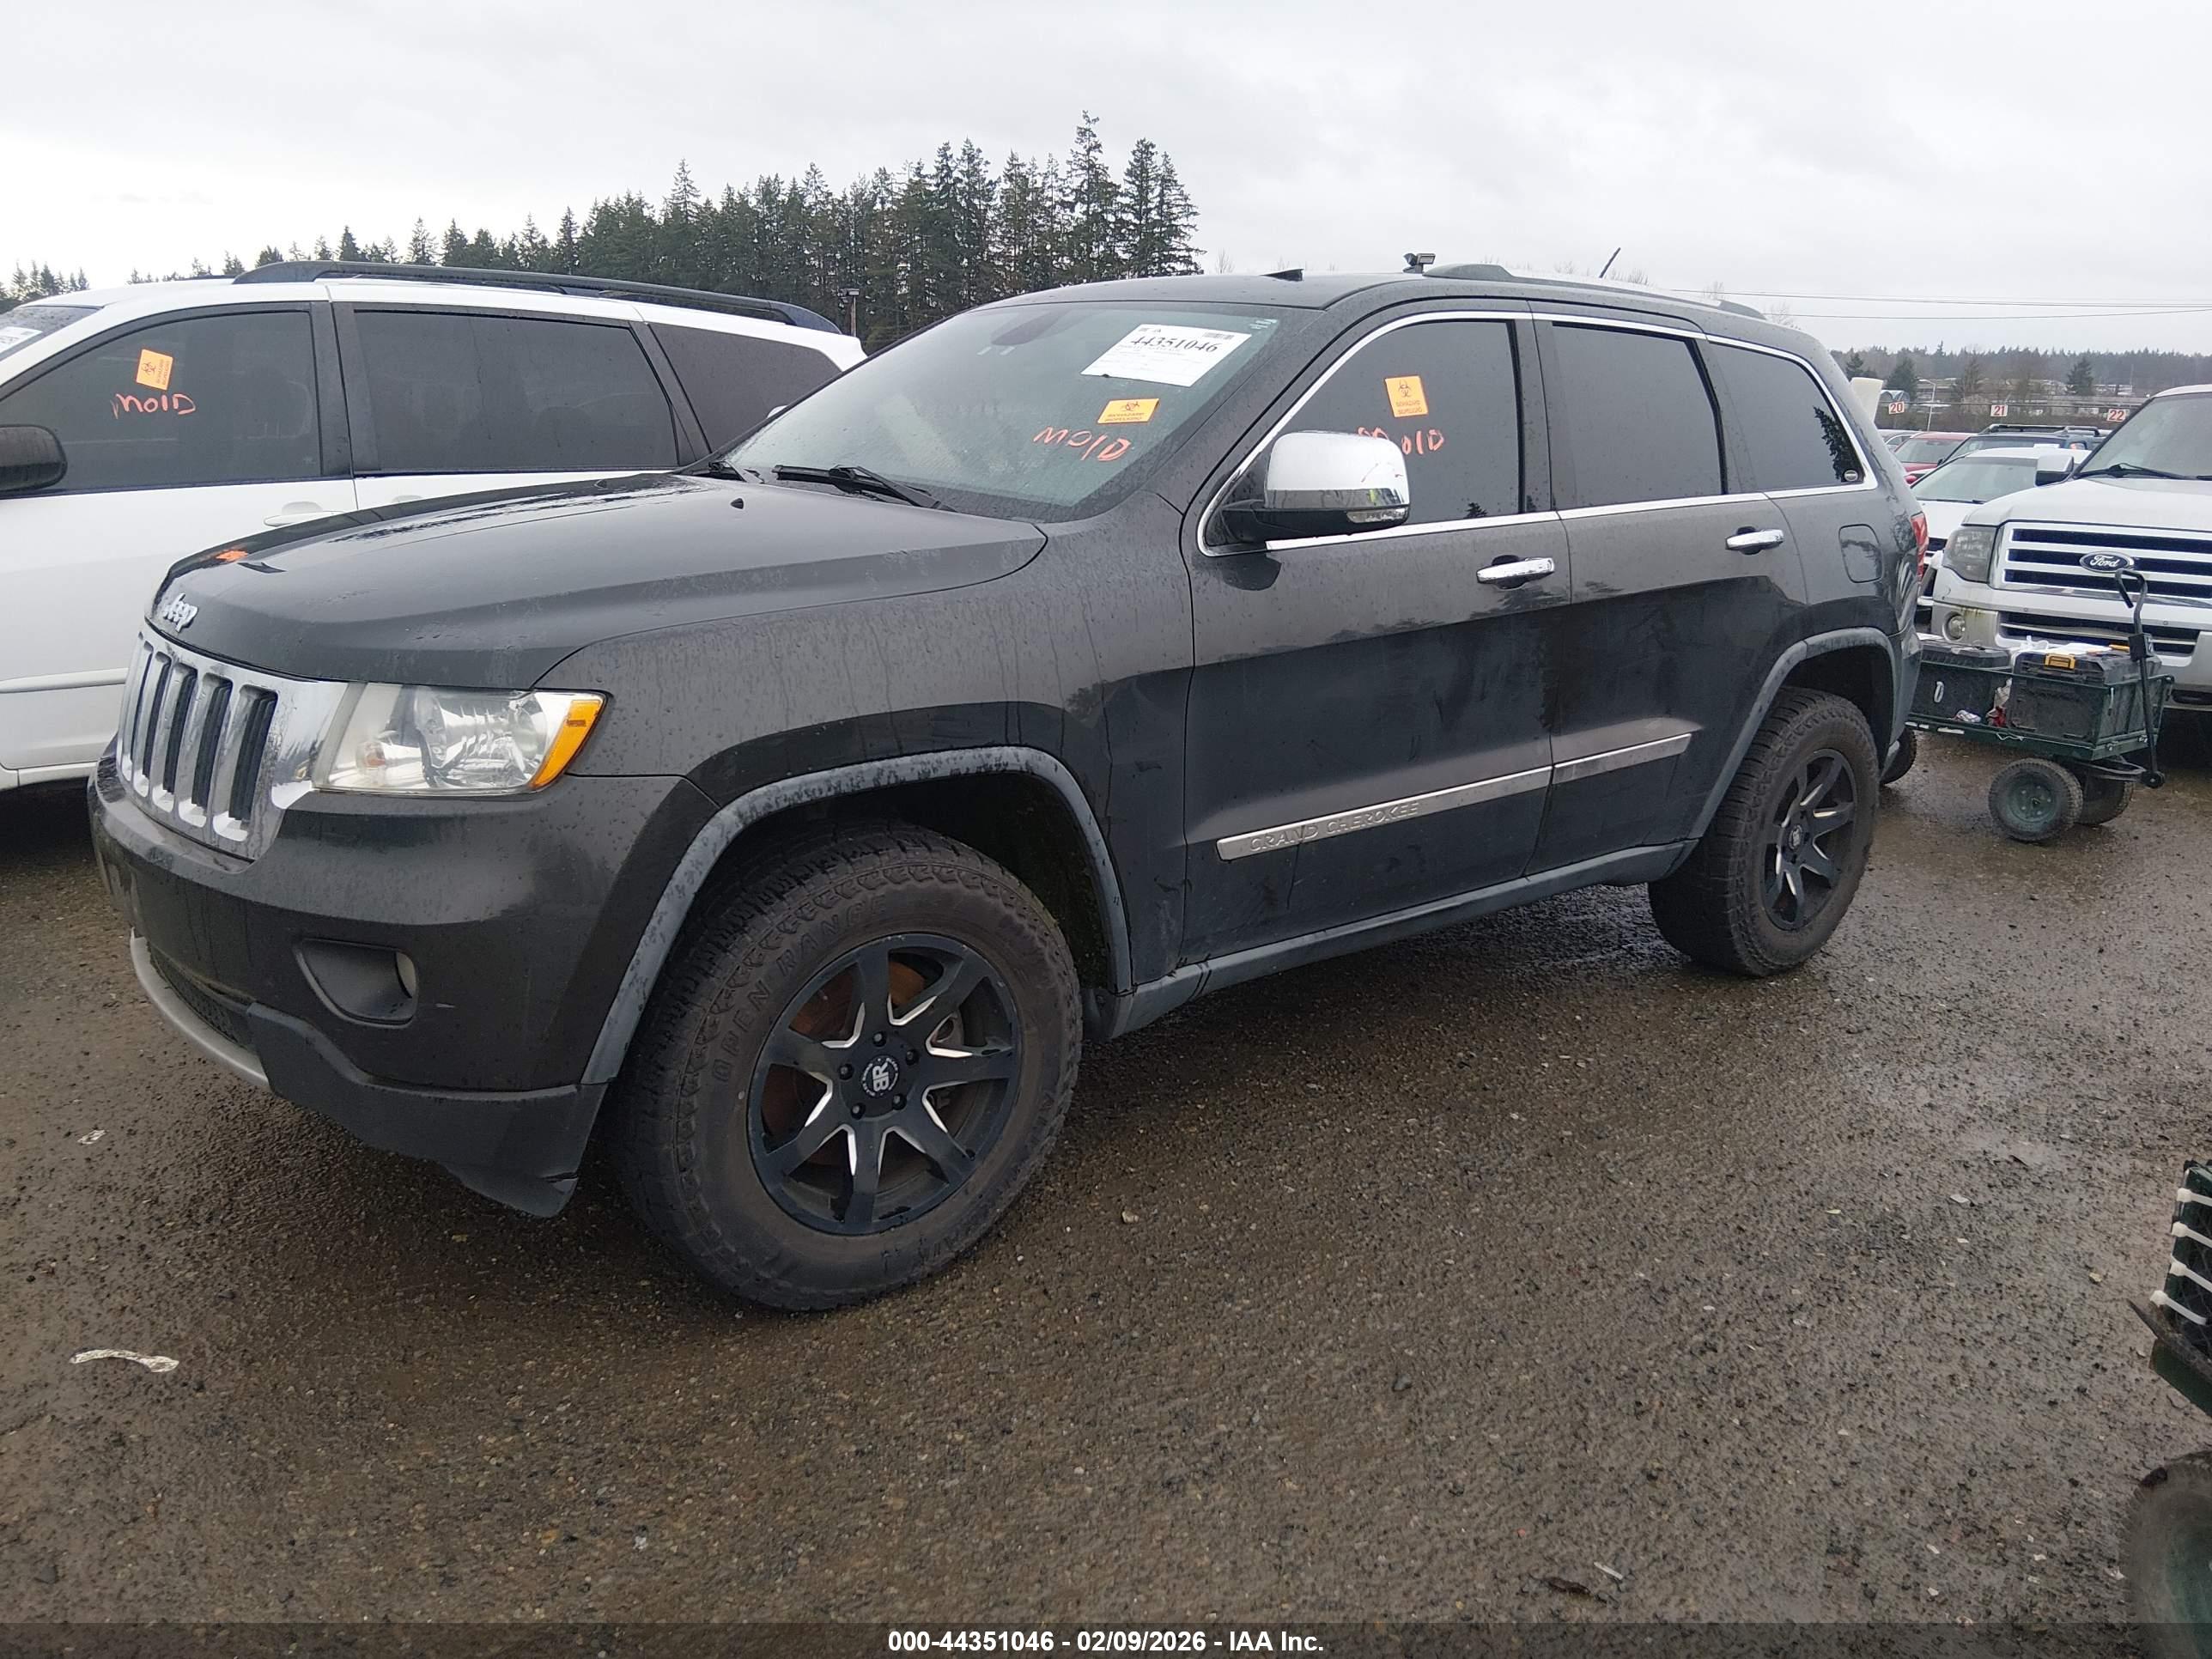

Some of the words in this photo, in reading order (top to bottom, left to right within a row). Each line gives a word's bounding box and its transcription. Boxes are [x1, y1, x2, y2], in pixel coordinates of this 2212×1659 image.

[1130, 335, 1223, 353] 44351046
[1889, 402, 1904, 413] 20
[1993, 405, 2006, 416] 21
[2109, 410, 2124, 421] 22
[2089, 554, 2120, 568] Ford
[1249, 823, 1319, 852] GRAND
[1326, 801, 1420, 836] CHEROKEE
